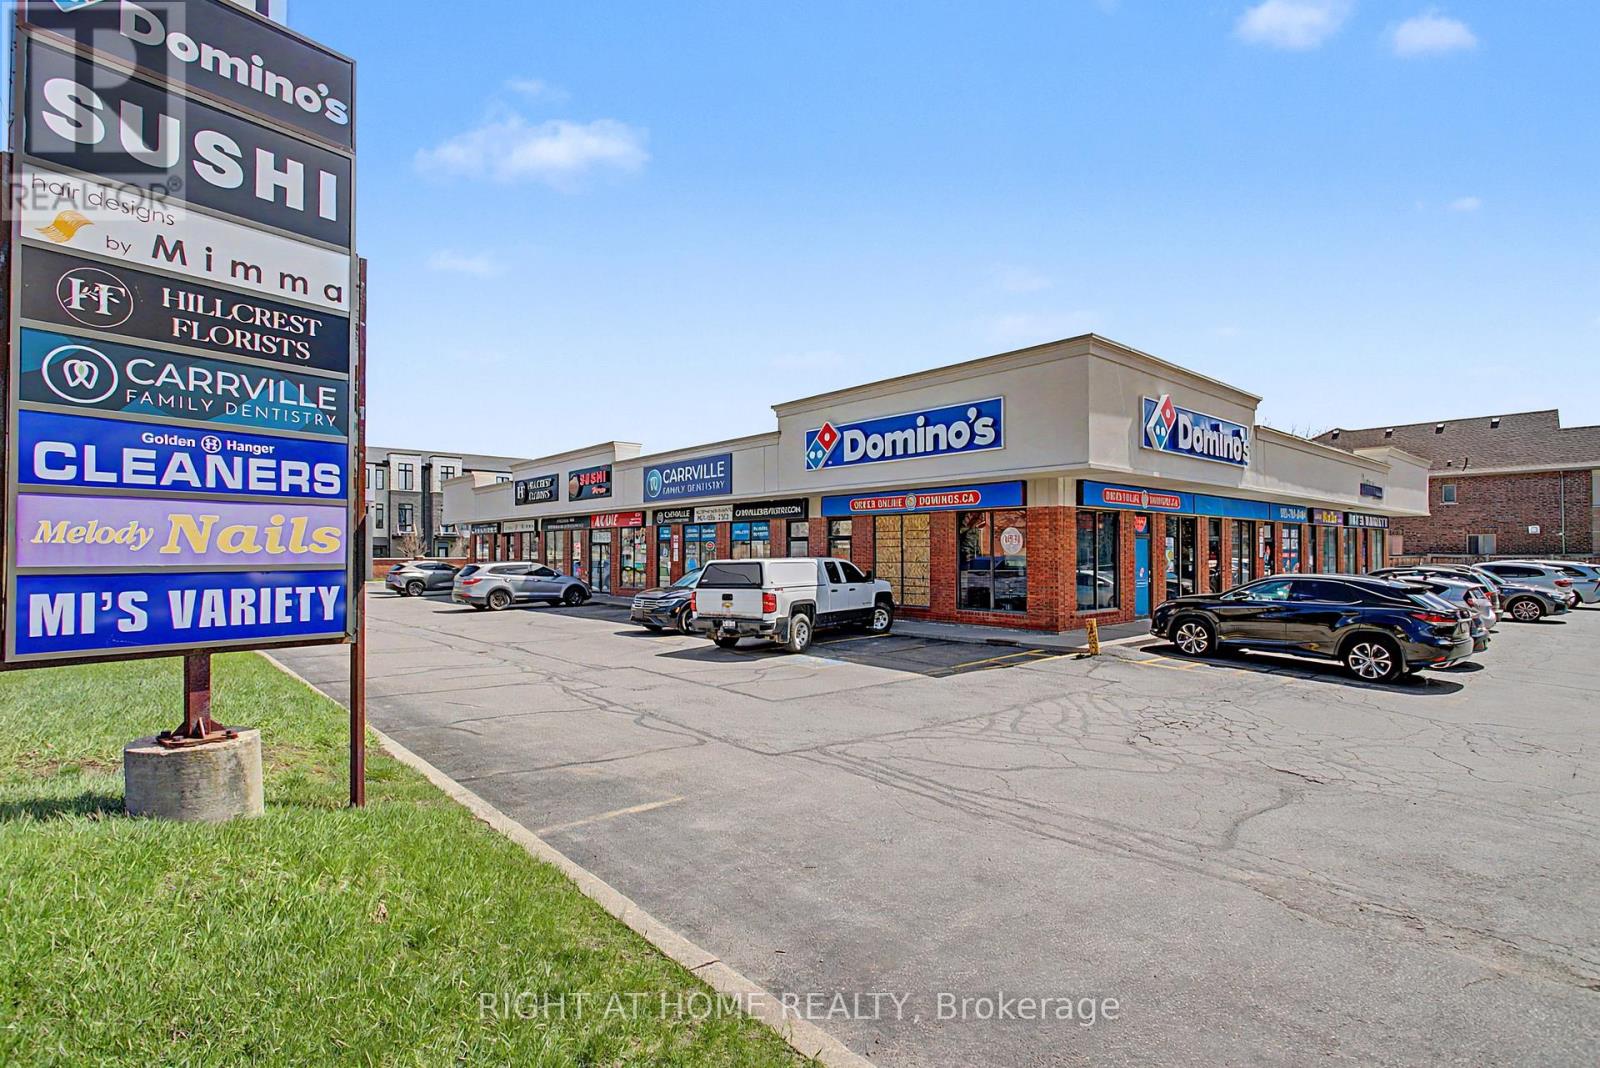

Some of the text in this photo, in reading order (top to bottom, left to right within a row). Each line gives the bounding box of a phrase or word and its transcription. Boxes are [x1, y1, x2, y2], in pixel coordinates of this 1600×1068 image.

[120, 0, 349, 125] Domino's
[42, 78, 338, 222] SUSHI
[32, 173, 175, 226] hair designs
[106, 234, 344, 304] by Mimma
[162, 287, 323, 337] HILLCREST
[172, 317, 311, 360] FLORISTS
[126, 359, 337, 411] CARRVILLE
[126, 389, 337, 427] FAMILY DENTISTRY
[142, 432, 196, 449] Golden
[226, 440, 275, 456] Hanger
[843, 407, 995, 462] Domino's
[34, 441, 341, 495] CLEANERS
[663, 461, 725, 484] CARRVILLE
[31, 514, 342, 555] Melody Nails
[29, 586, 341, 638] MI'S VARIETY
